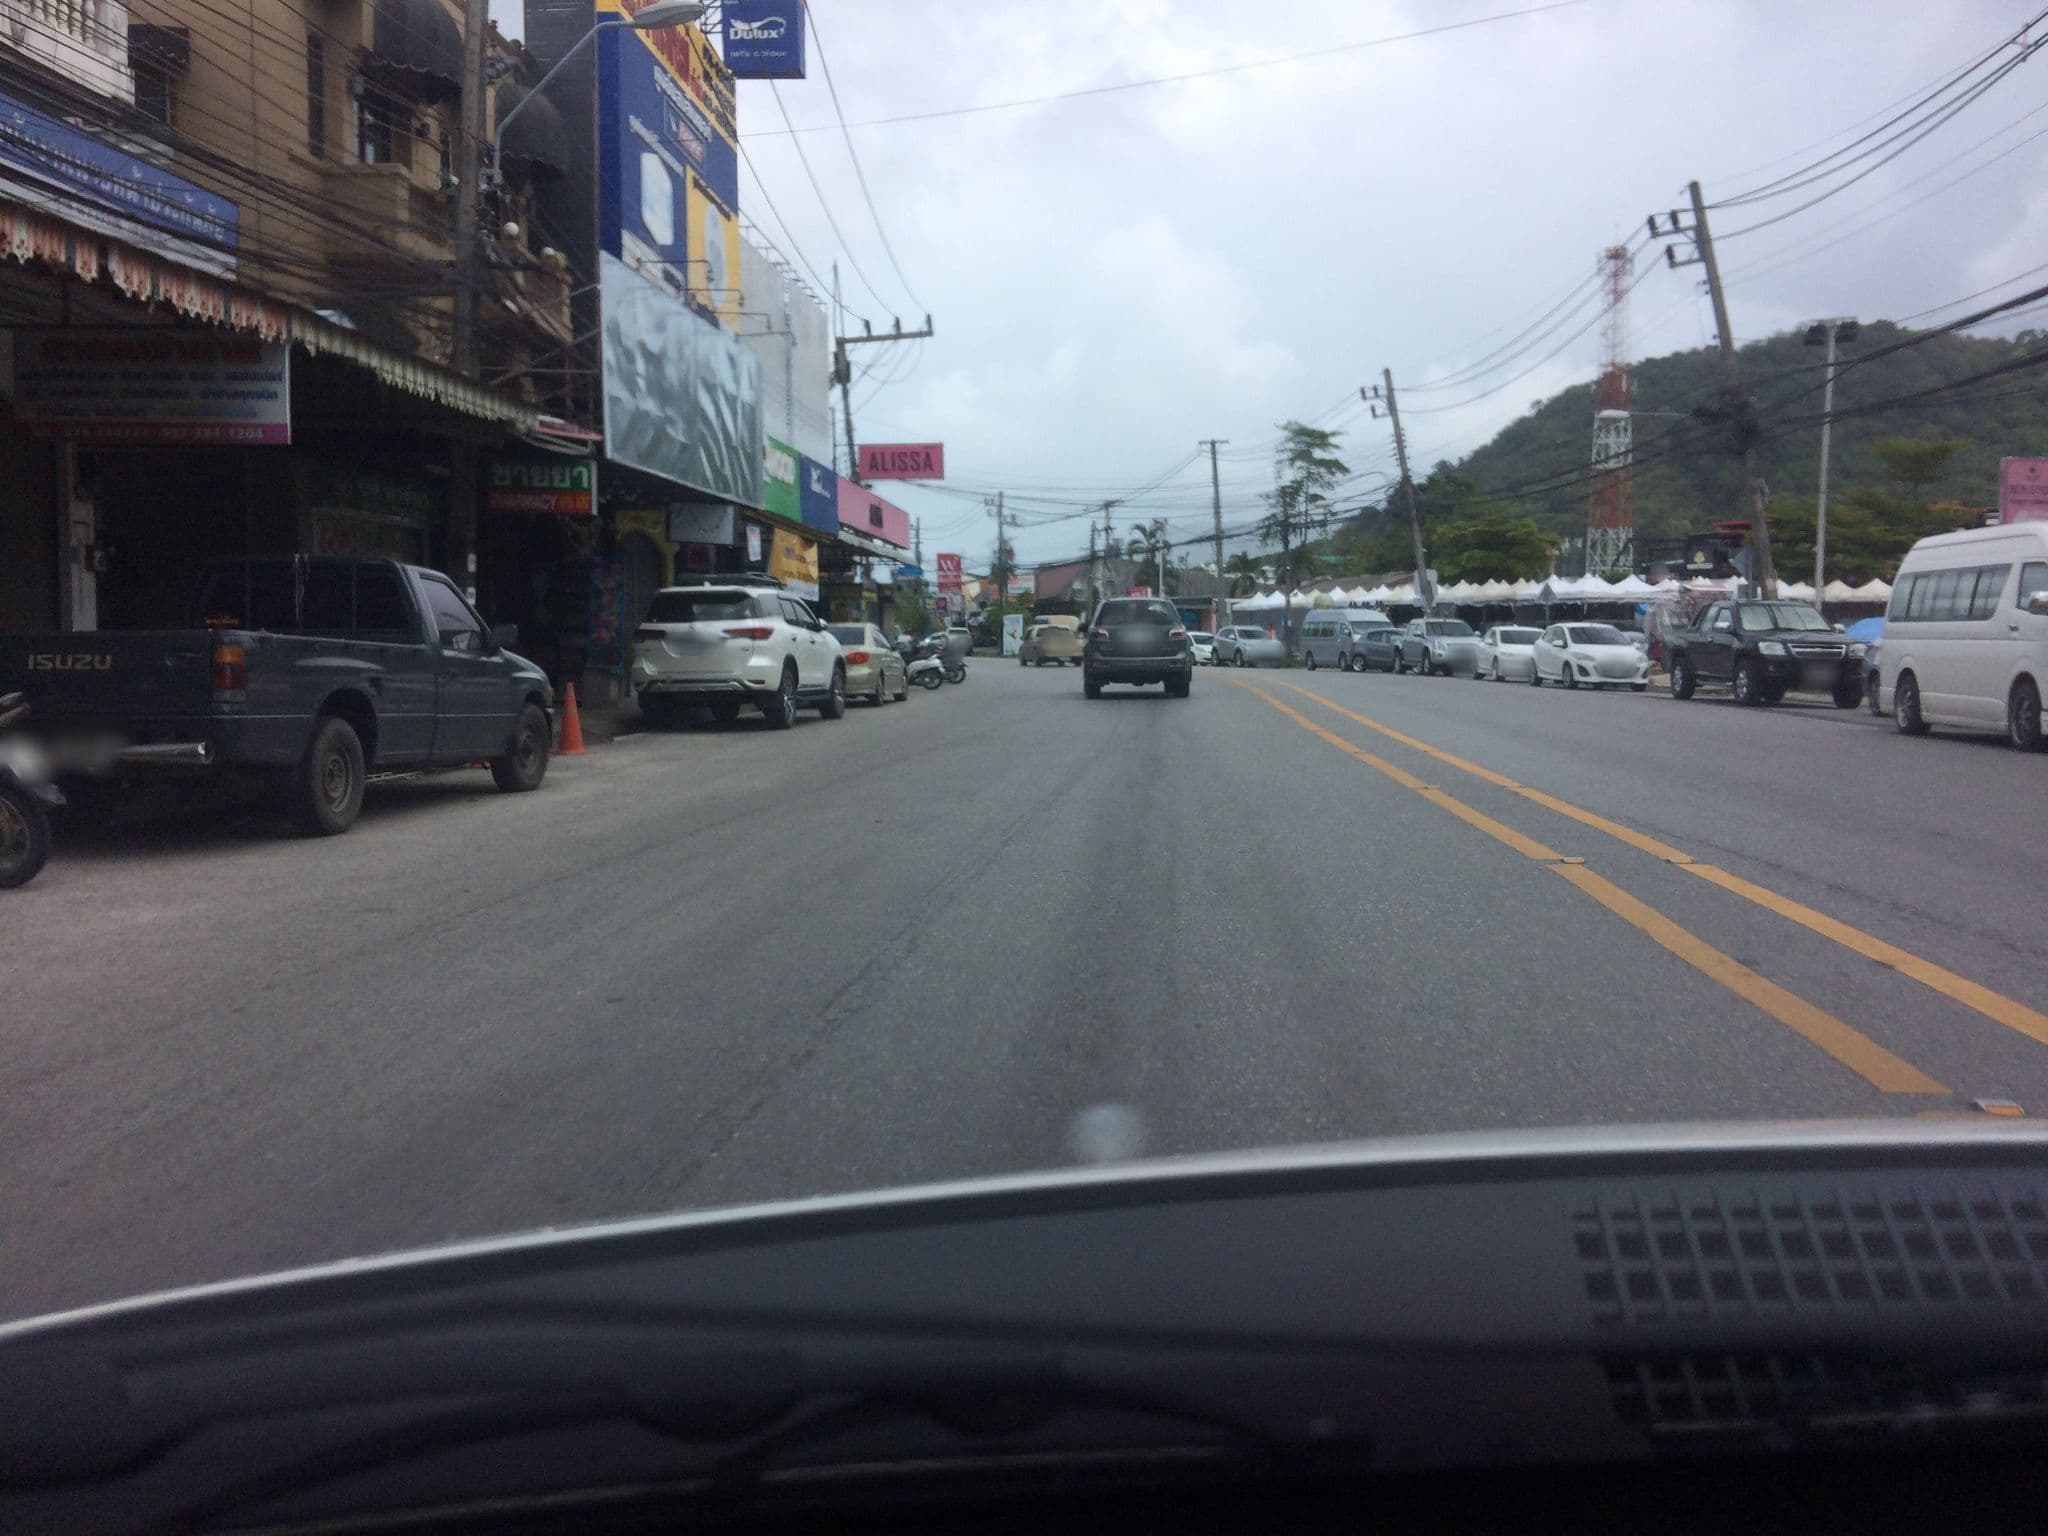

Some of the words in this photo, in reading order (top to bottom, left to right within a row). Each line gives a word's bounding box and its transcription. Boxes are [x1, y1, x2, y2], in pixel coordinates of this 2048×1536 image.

[729, 28, 779, 40] Dulux
[868, 452, 934, 473] ALISSA
[27, 653, 112, 670] ISUZU
